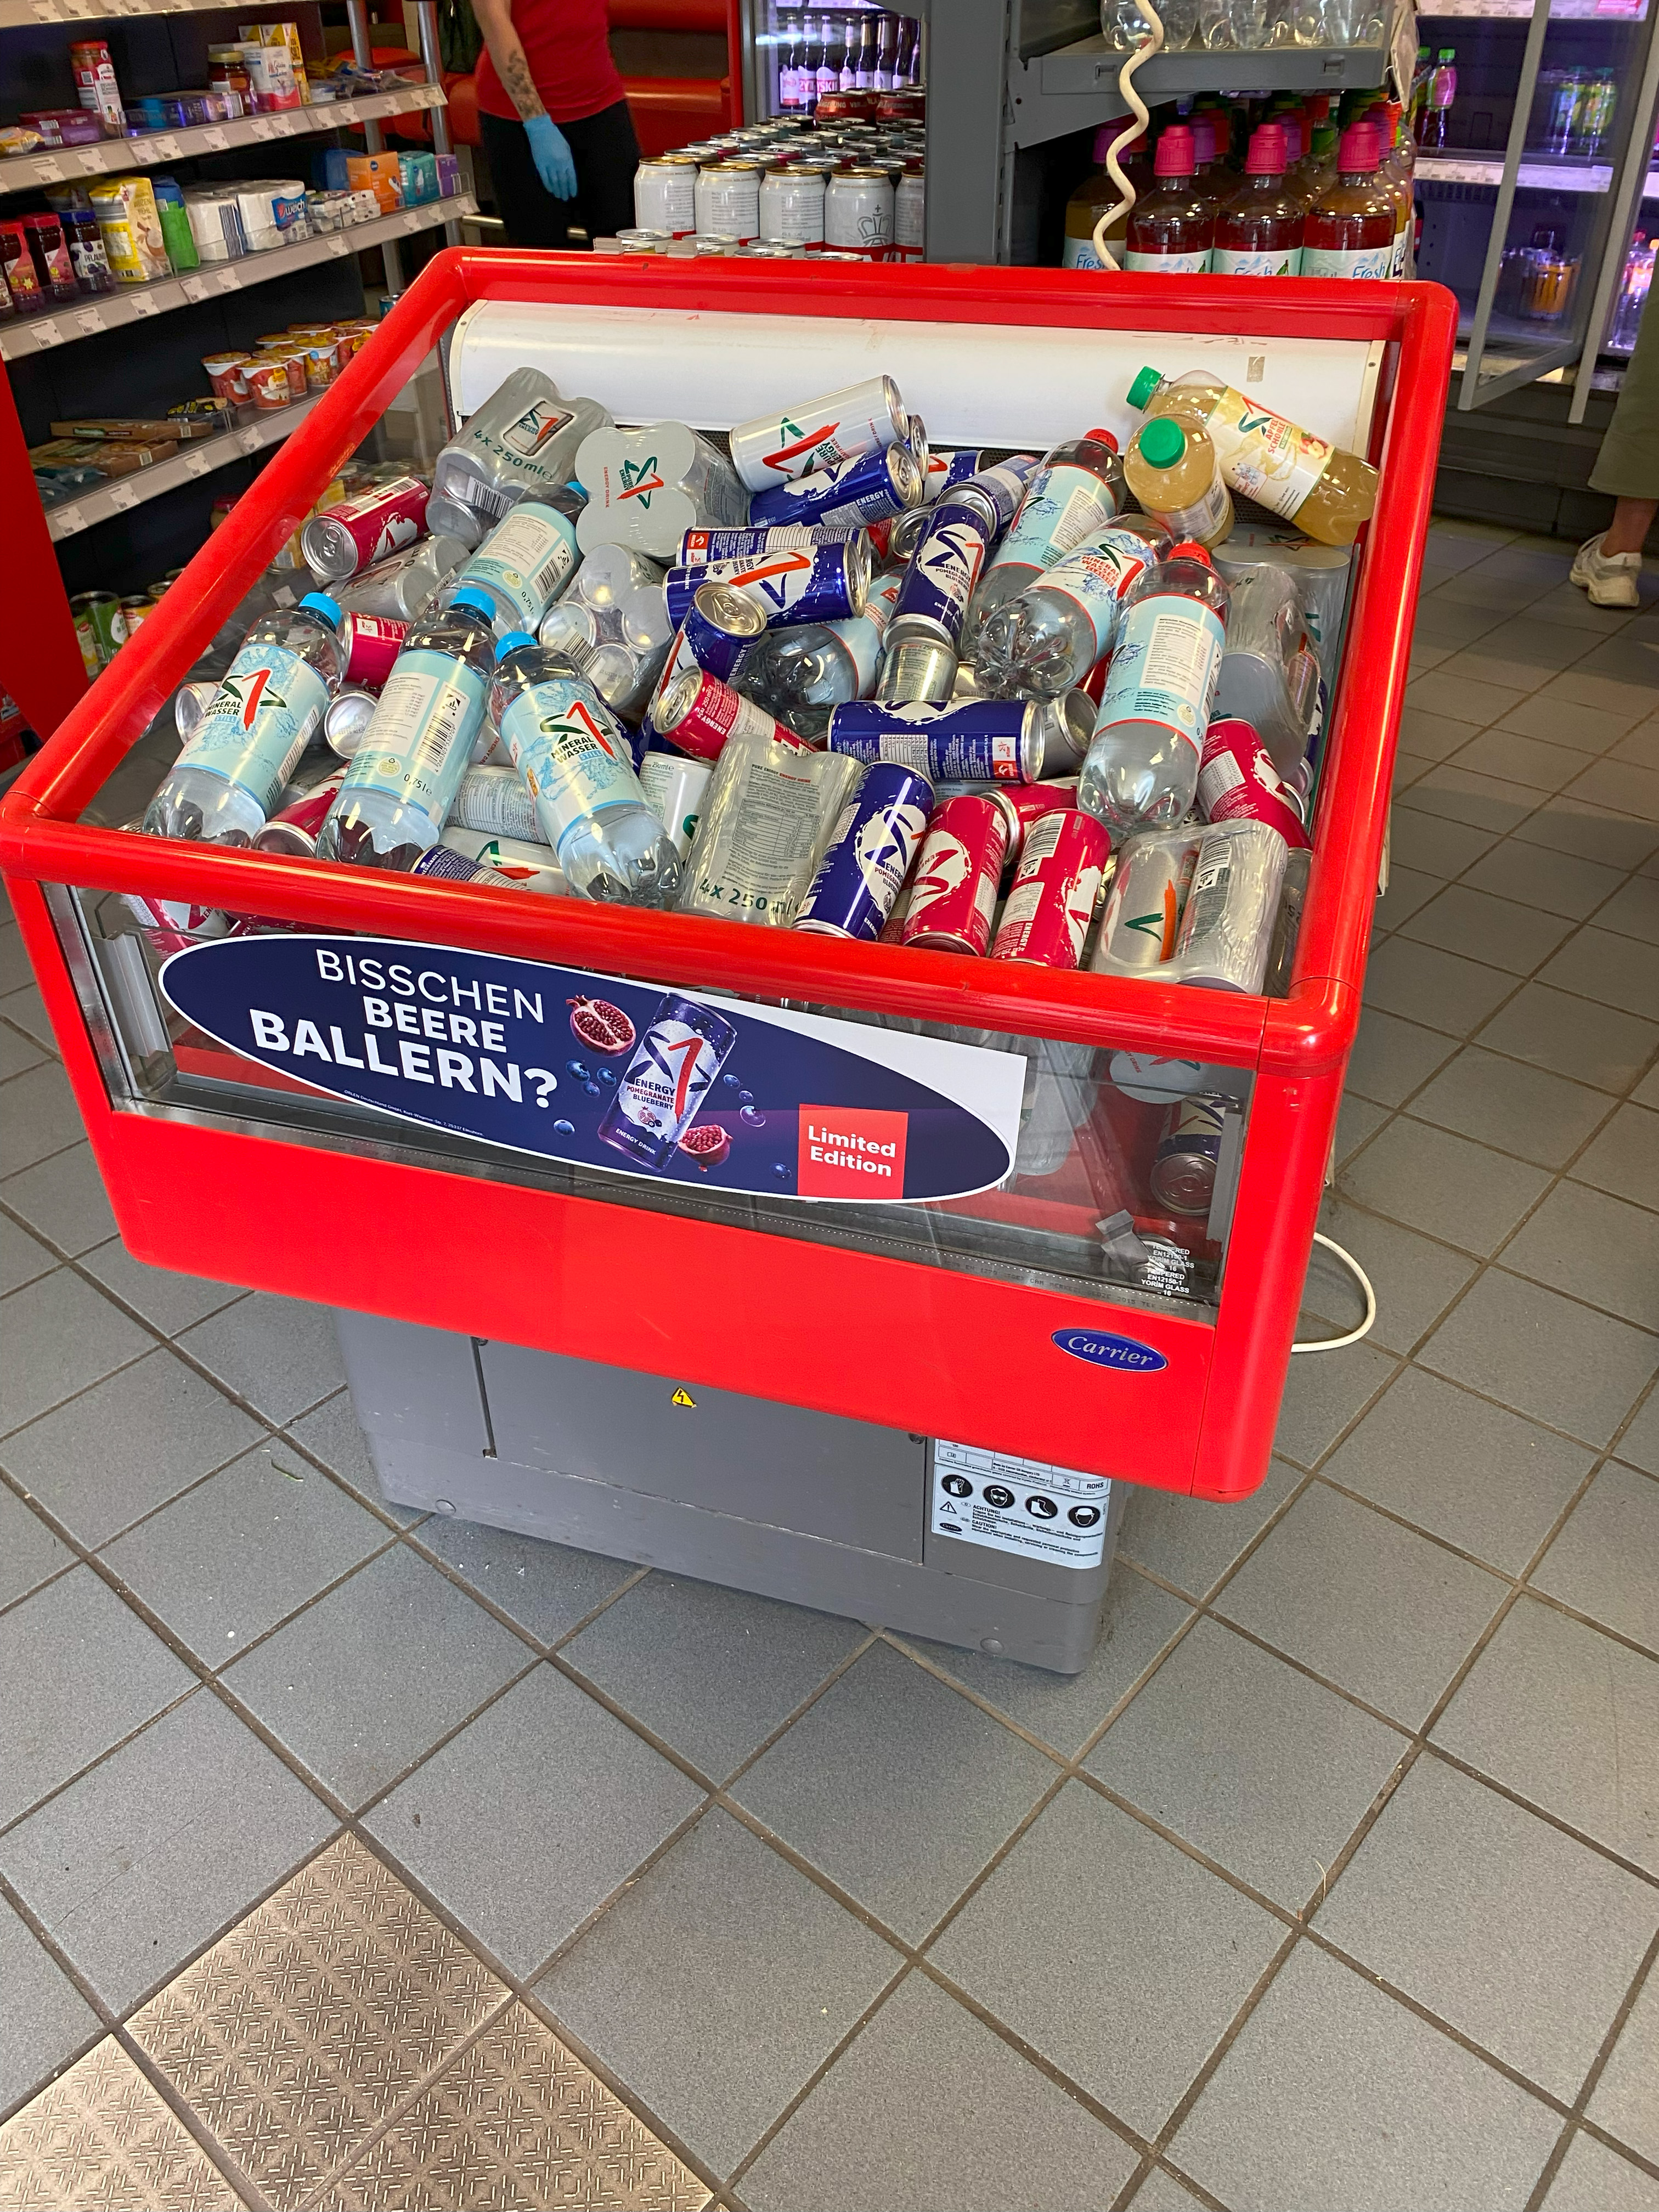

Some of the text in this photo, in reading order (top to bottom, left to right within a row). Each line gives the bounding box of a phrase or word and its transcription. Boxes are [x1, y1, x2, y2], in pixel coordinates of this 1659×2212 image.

[285, 199, 304, 216] weich
[1076, 254, 1105, 269] Fres
[1265, 419, 1279, 441] APFEL
[1268, 421, 1286, 454] SCHORLE
[619, 469, 630, 491] ENERGY
[856, 490, 884, 506] ENERGY
[1081, 556, 1120, 579] MINERAL
[1081, 560, 1118, 583] WASSER
[730, 649, 747, 676] ENERGY
[205, 708, 240, 718] WASSER
[207, 701, 241, 711] MINERAL
[701, 715, 727, 735] ENERGY
[551, 736, 594, 759] MINERAL
[557, 743, 599, 764] WASSER
[580, 751, 602, 760] STILL
[699, 878, 724, 900] 4x
[1019, 922, 1033, 947] ENERGY
[317, 949, 544, 1024] BISSCHEN
[363, 996, 507, 1053] BEERE
[249, 1008, 558, 1109] BALLERN?
[627, 1086, 675, 1104] POMEGRANATE
[635, 1078, 676, 1096] ENERGY
[344, 1090, 360, 1099] ORLEN
[360, 1095, 387, 1108] Deutschland
[633, 1094, 674, 1110] BLUEBERRY
[616, 1127, 656, 1155] ENERGY DRINK
[808, 1125, 896, 1158] Limited
[810, 1146, 892, 1177] Edition
[1147, 1274, 1182, 1286] EN12150-1
[1165, 1284, 1190, 1294] GLASS
[1068, 1336, 1153, 1366] Carrier
[973, 1504, 1000, 1514] ACHTUNG!
[972, 1520, 997, 1530] CAUTION!
